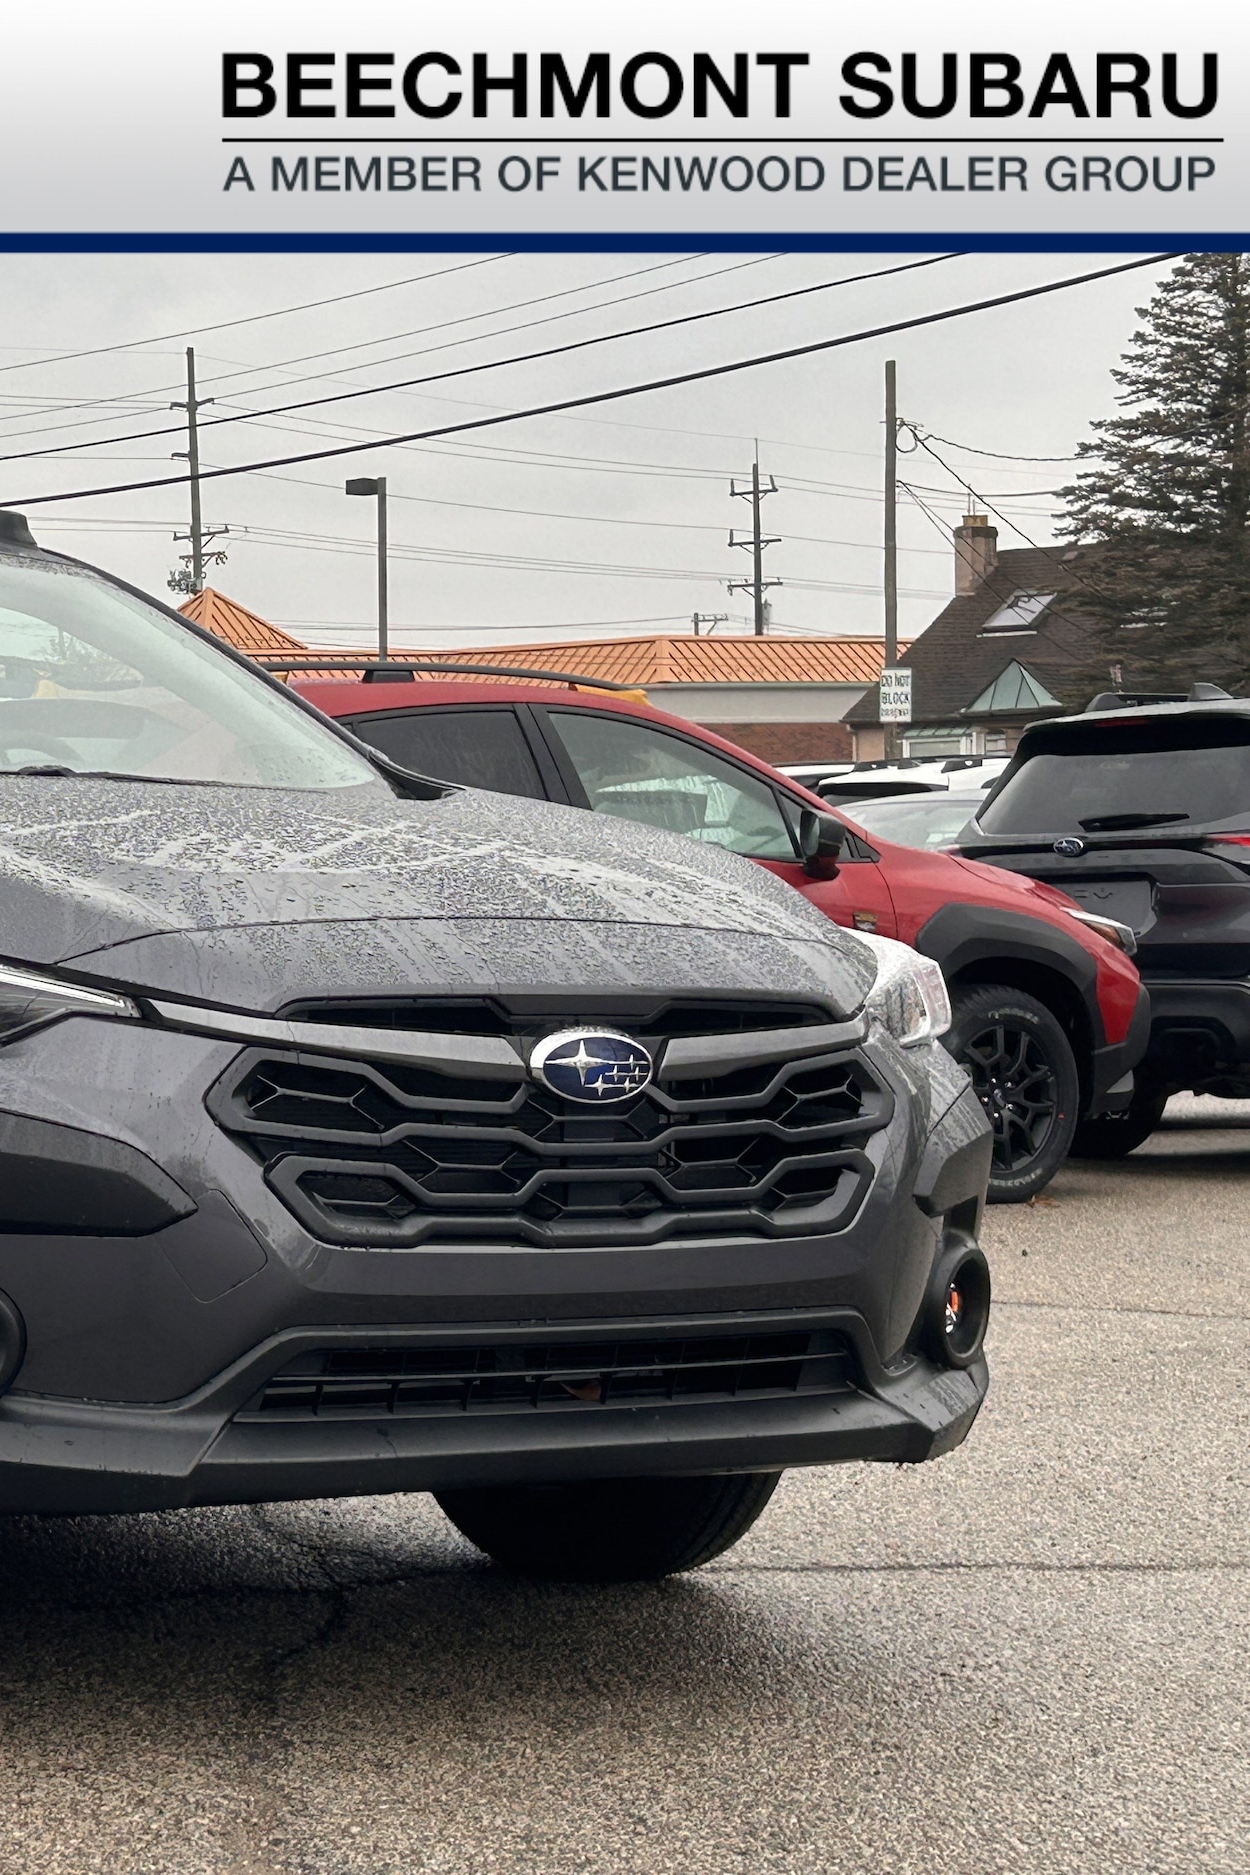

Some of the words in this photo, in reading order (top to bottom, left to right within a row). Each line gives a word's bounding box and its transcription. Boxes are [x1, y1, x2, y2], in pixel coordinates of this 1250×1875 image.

[881, 674, 893, 687] DO
[894, 673, 910, 687] NOT
[881, 691, 910, 704] BLOCK
